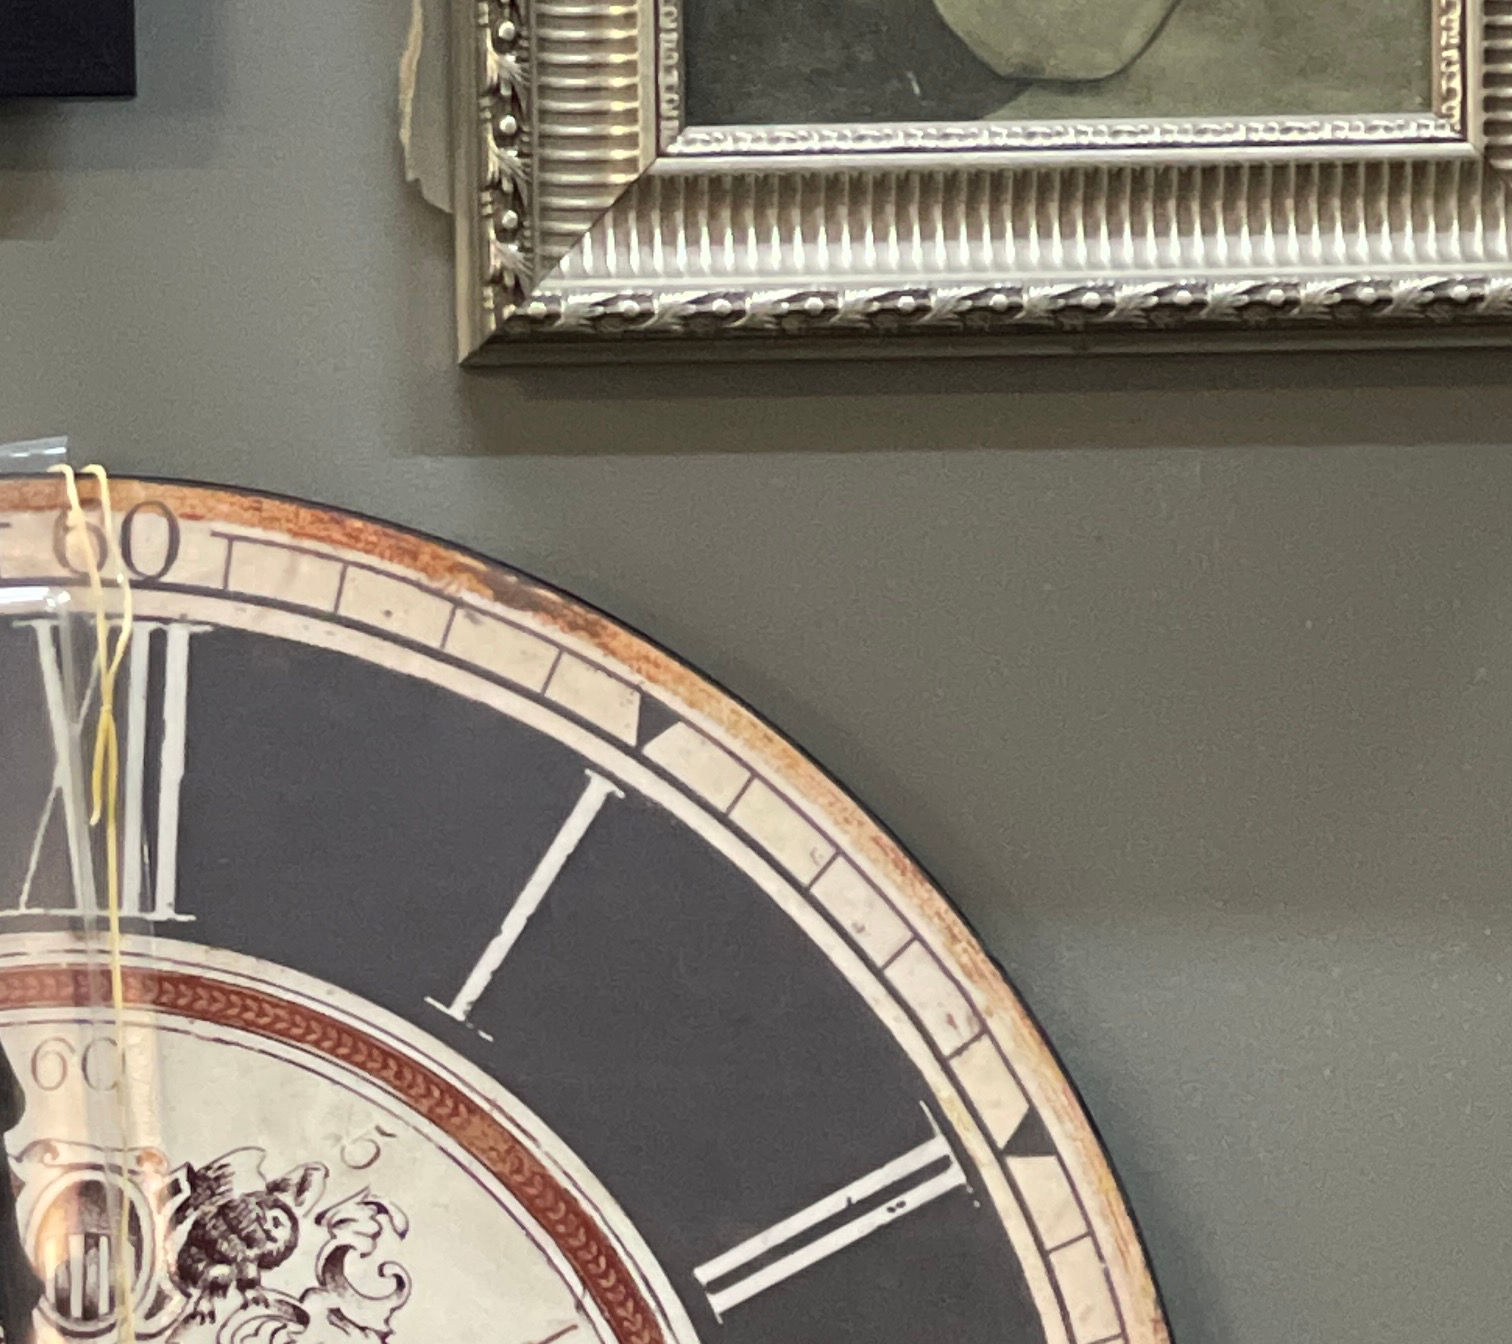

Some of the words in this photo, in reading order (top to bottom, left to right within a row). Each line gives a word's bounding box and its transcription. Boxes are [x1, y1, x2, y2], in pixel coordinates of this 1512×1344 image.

[52, 500, 178, 580] 60
[424, 769, 625, 1042] I
[339, 1125, 396, 1170] 5
[693, 1100, 980, 1324] II
